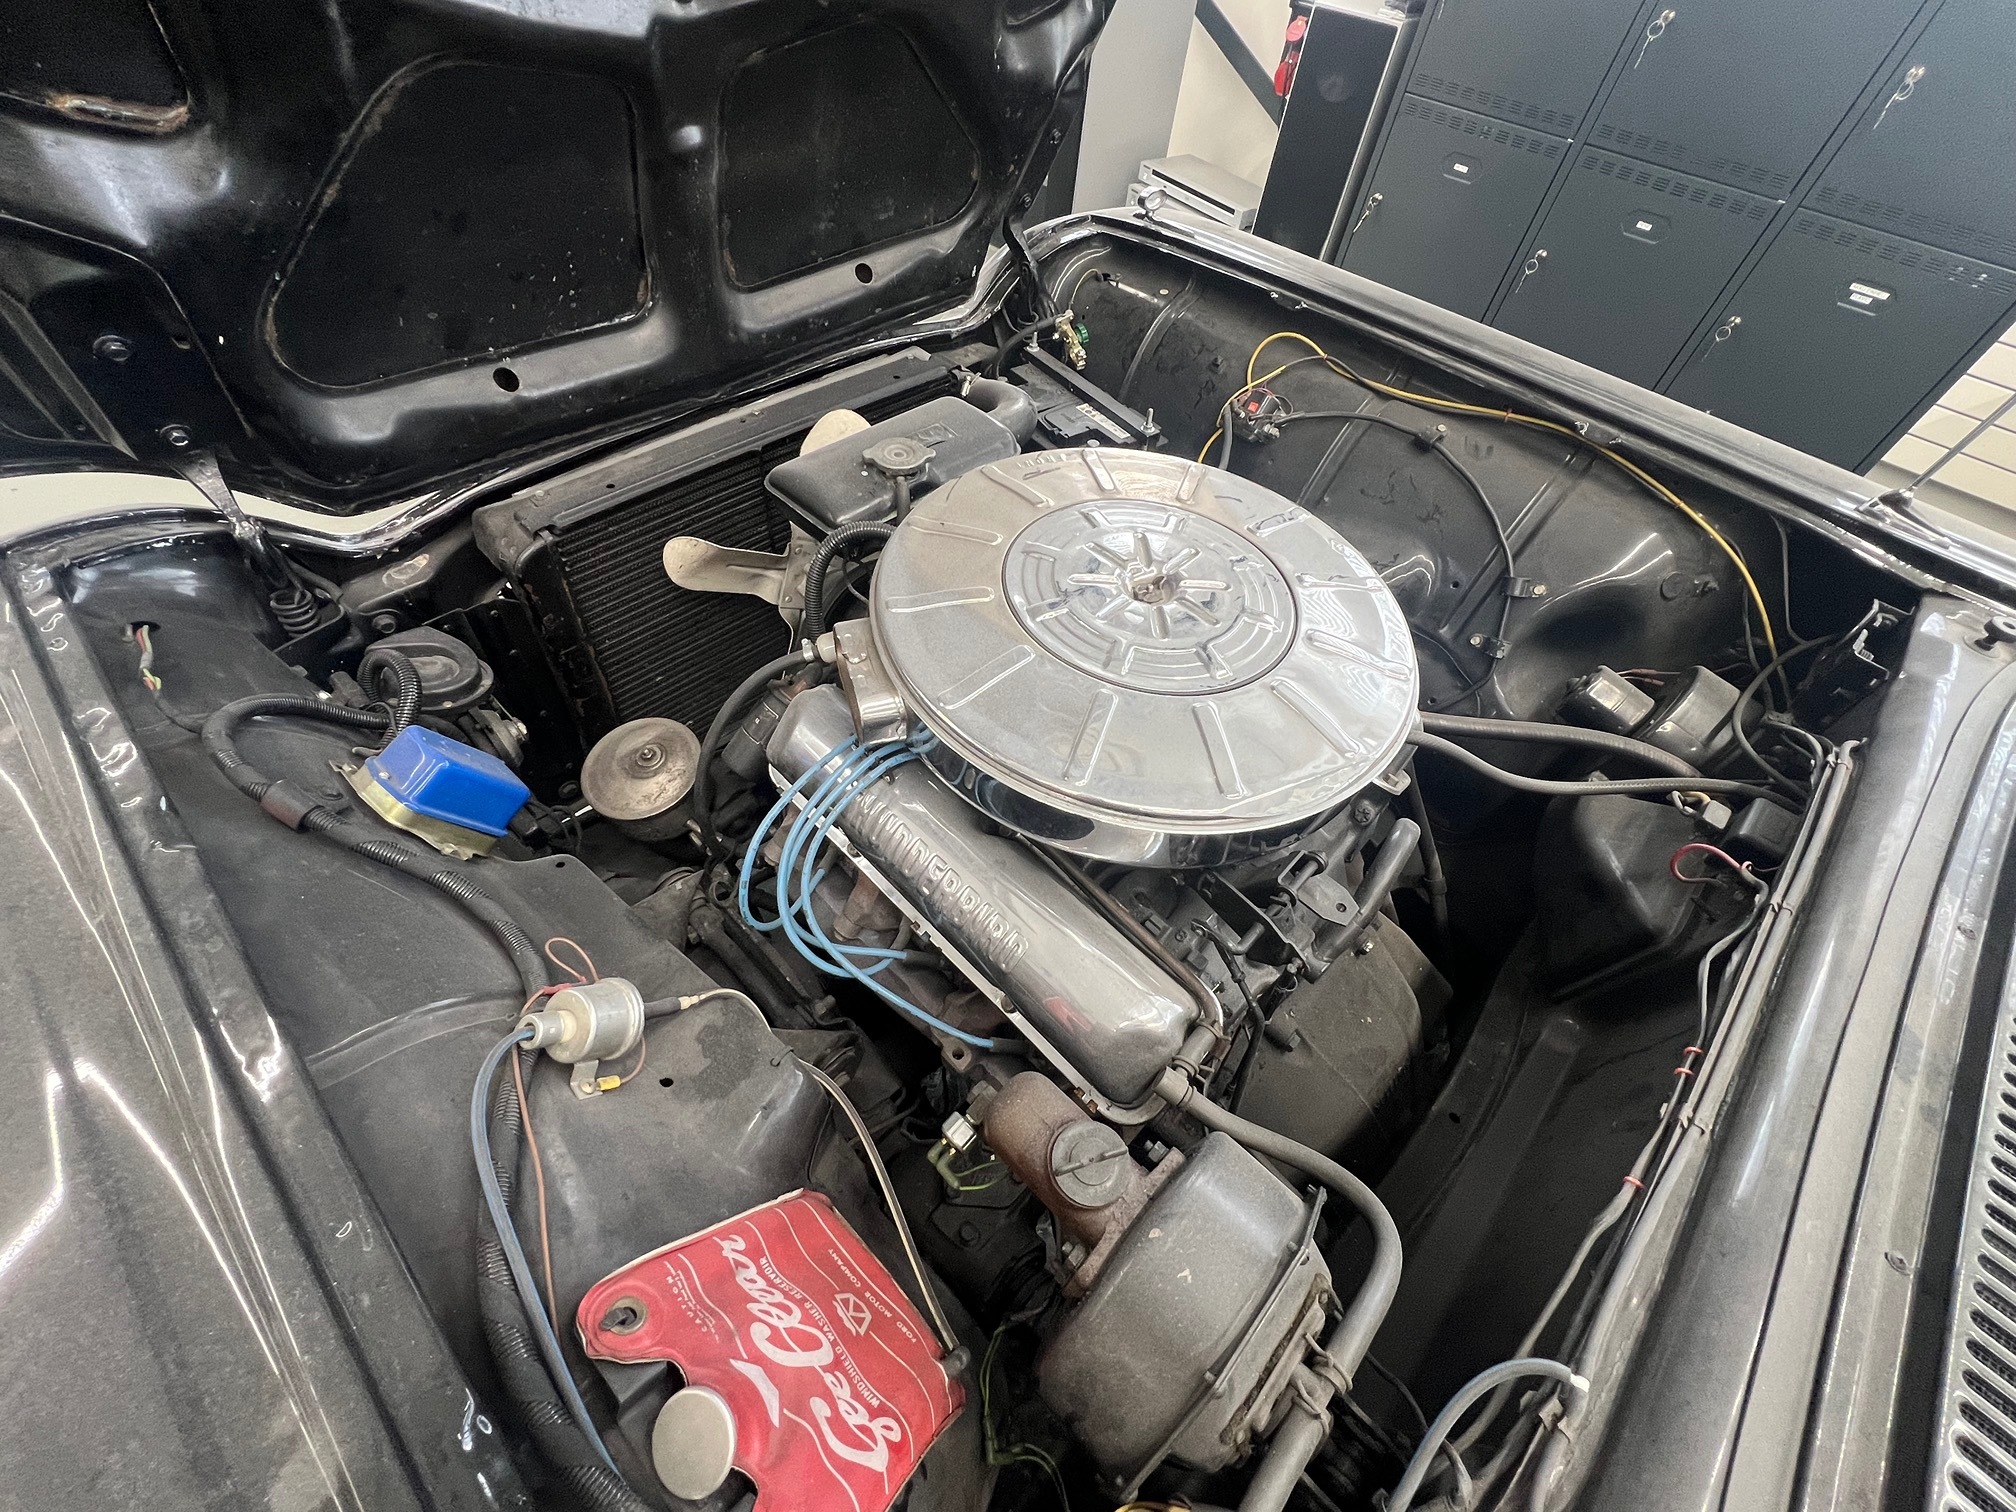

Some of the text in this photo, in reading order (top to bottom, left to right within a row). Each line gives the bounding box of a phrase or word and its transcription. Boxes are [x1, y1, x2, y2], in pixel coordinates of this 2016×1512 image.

[666, 1276, 707, 1332] CAUTION
[759, 1255, 881, 1409] WINDSHIELD WASHER RESERVOIR
[828, 1248, 918, 1343] FORD MOTOR COMPANY
